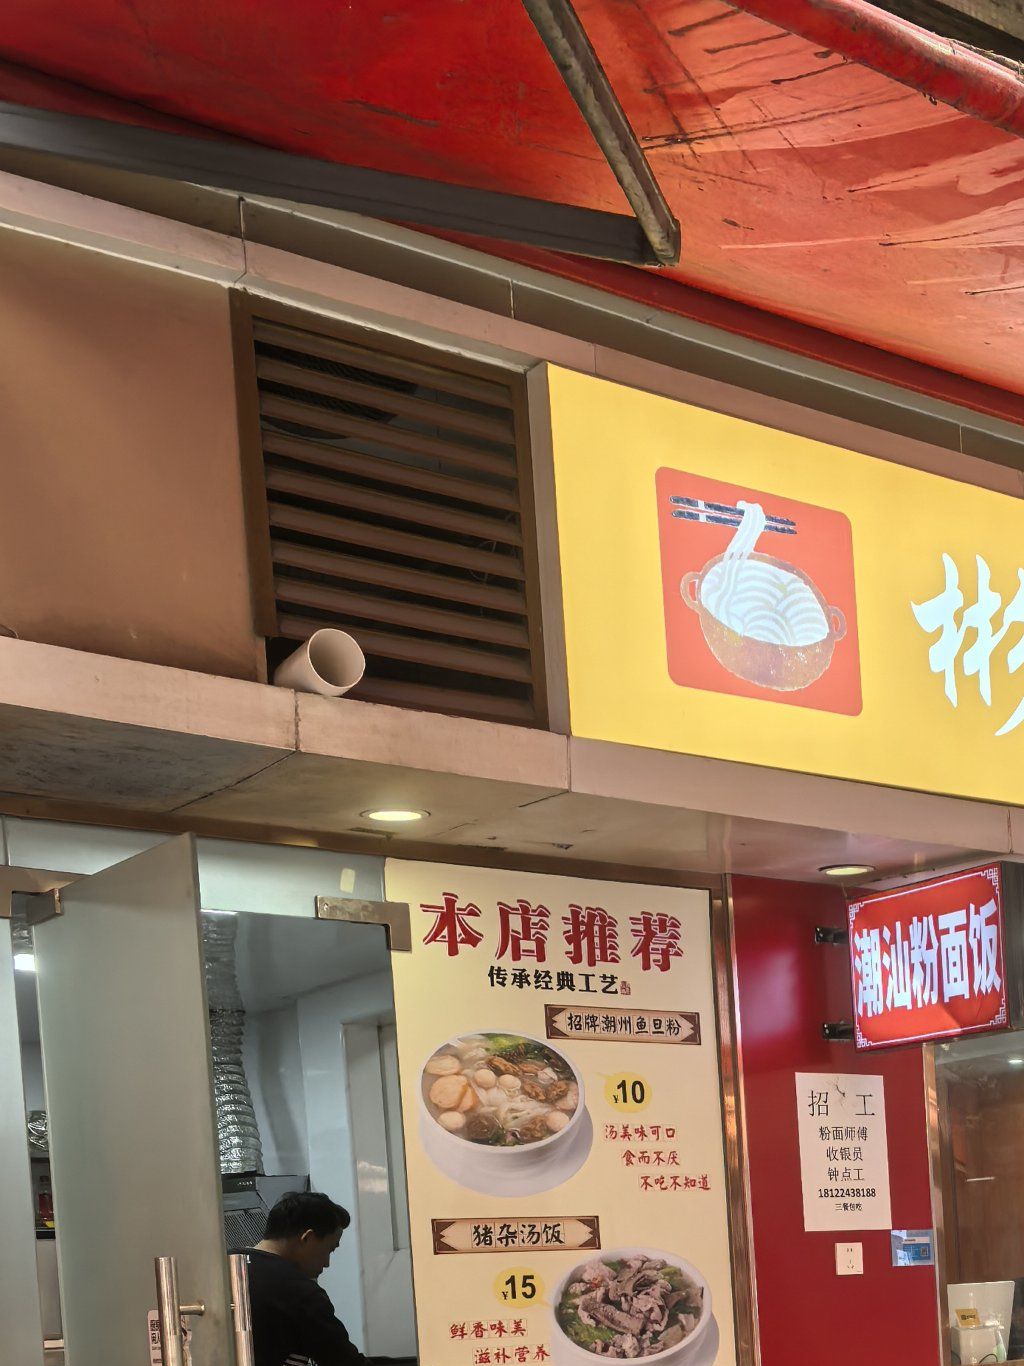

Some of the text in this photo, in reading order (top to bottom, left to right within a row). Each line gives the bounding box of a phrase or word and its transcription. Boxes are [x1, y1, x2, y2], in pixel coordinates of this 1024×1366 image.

[419, 890, 685, 975] 本店推荐
[853, 899, 1001, 1018] 潮汕粉面饭
[487, 965, 620, 995] 传承经典工艺
[567, 1011, 682, 1037] 招牌潮州鱼旦粉
[807, 1090, 876, 1117] 招工
[604, 1123, 677, 1141] 汤美味可口
[818, 1126, 868, 1141] 粉面师傅
[621, 1149, 681, 1167] 食而不厌
[826, 1146, 864, 1162] 收银员
[640, 1173, 712, 1191] 不吃不知道
[827, 1167, 865, 1182] 钟点工
[818, 1188, 876, 1199] 18122438188
[834, 1202, 863, 1211] 三餐包吃
[472, 1223, 566, 1247] 猪杂汤饭
[450, 1319, 527, 1340] 鲜香味美
[473, 1344, 551, 1366] 滋补营养
